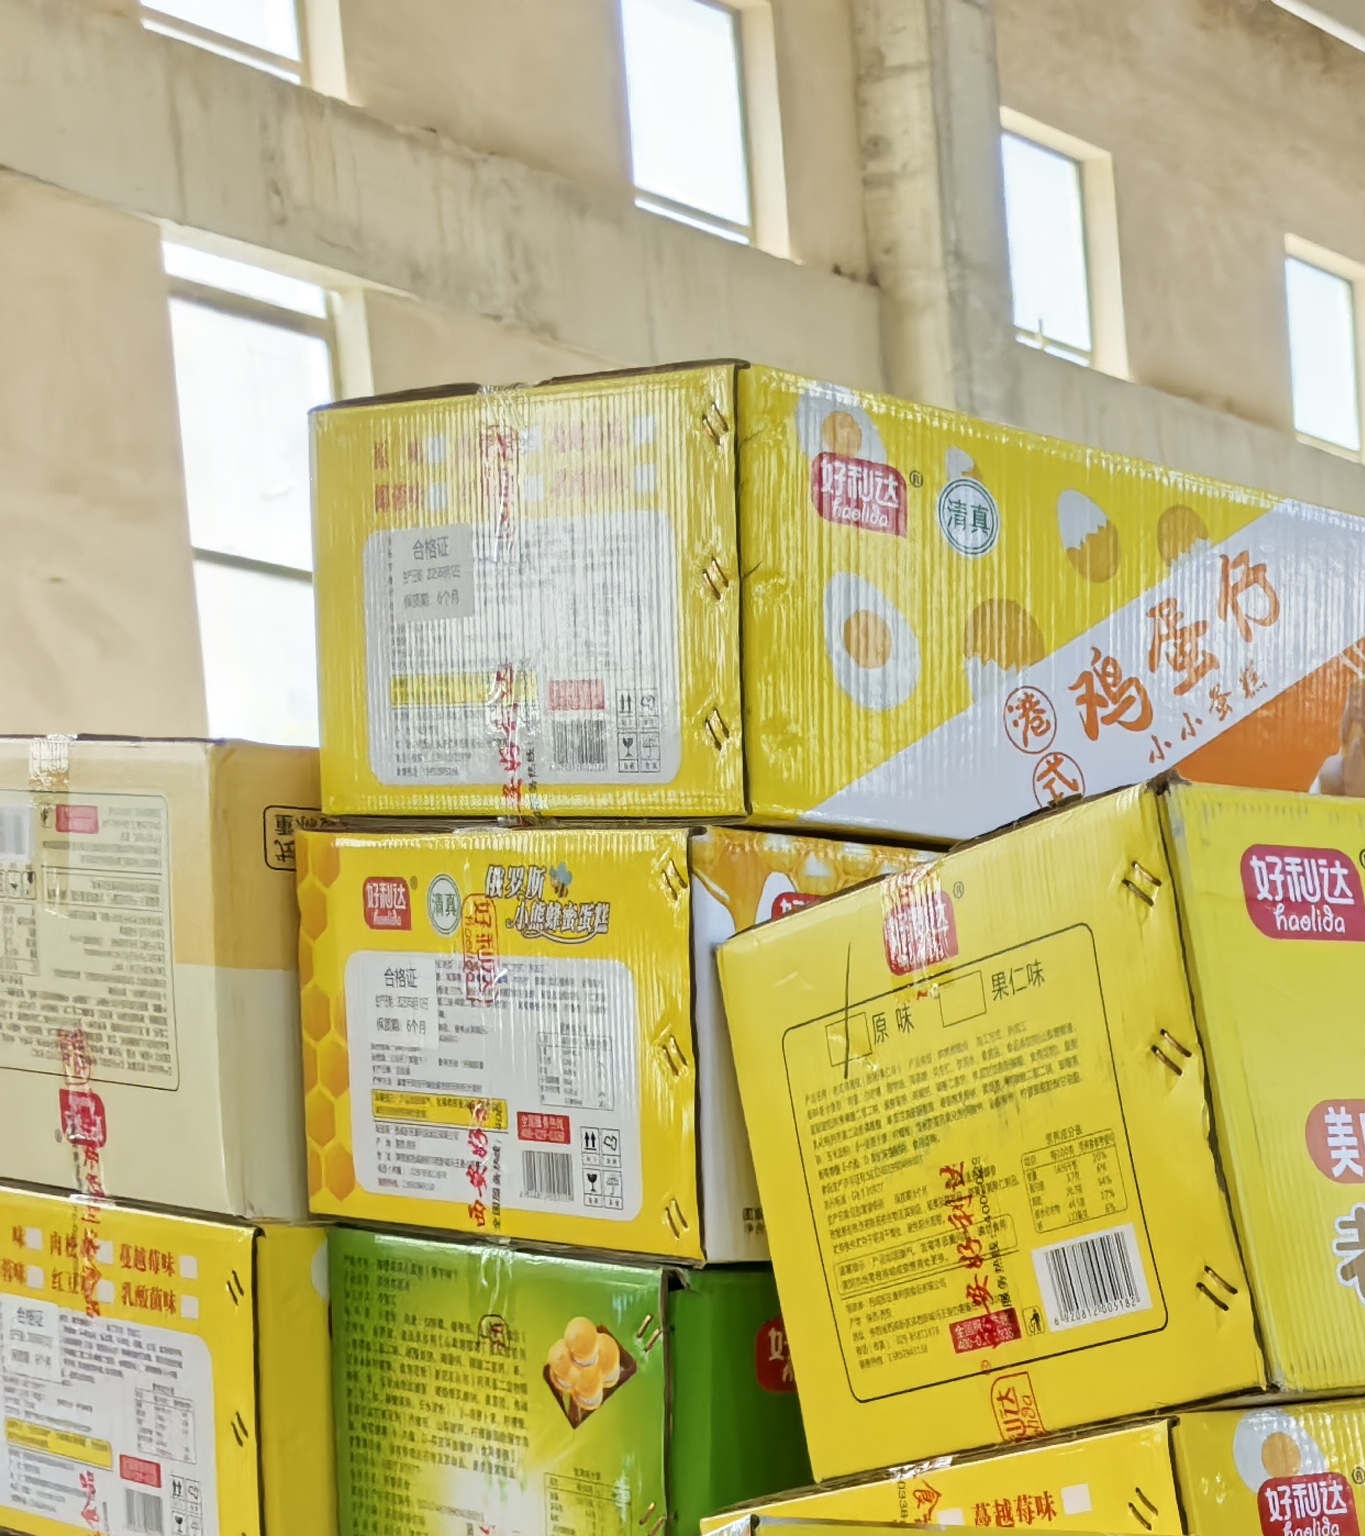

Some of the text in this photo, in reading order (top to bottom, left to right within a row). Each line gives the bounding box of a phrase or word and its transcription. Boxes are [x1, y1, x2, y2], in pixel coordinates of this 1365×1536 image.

[820, 458, 900, 510] 好利达
[945, 498, 991, 534] 清真
[412, 536, 450, 562] 合格证
[1068, 549, 1281, 742] 鸡蛋仔
[366, 882, 407, 909] 好利达
[485, 865, 547, 900] 俄罗斯
[1248, 852, 1355, 906] 好利达
[431, 892, 459, 918] 清真
[506, 901, 611, 934] 小熊蜂蜜蛋糕
[1273, 902, 1346, 936] haolida
[384, 967, 418, 989] 合格证
[991, 959, 1046, 1002] 果仁味
[872, 1003, 915, 1041] 原味
[119, 1242, 176, 1278] 蔓越莓味
[121, 1280, 177, 1316] 乳酸菌味
[912, 1479, 942, 1524] 食
[971, 1490, 1057, 1528] 蔓越莓味
[1263, 1478, 1350, 1526] 好利达
